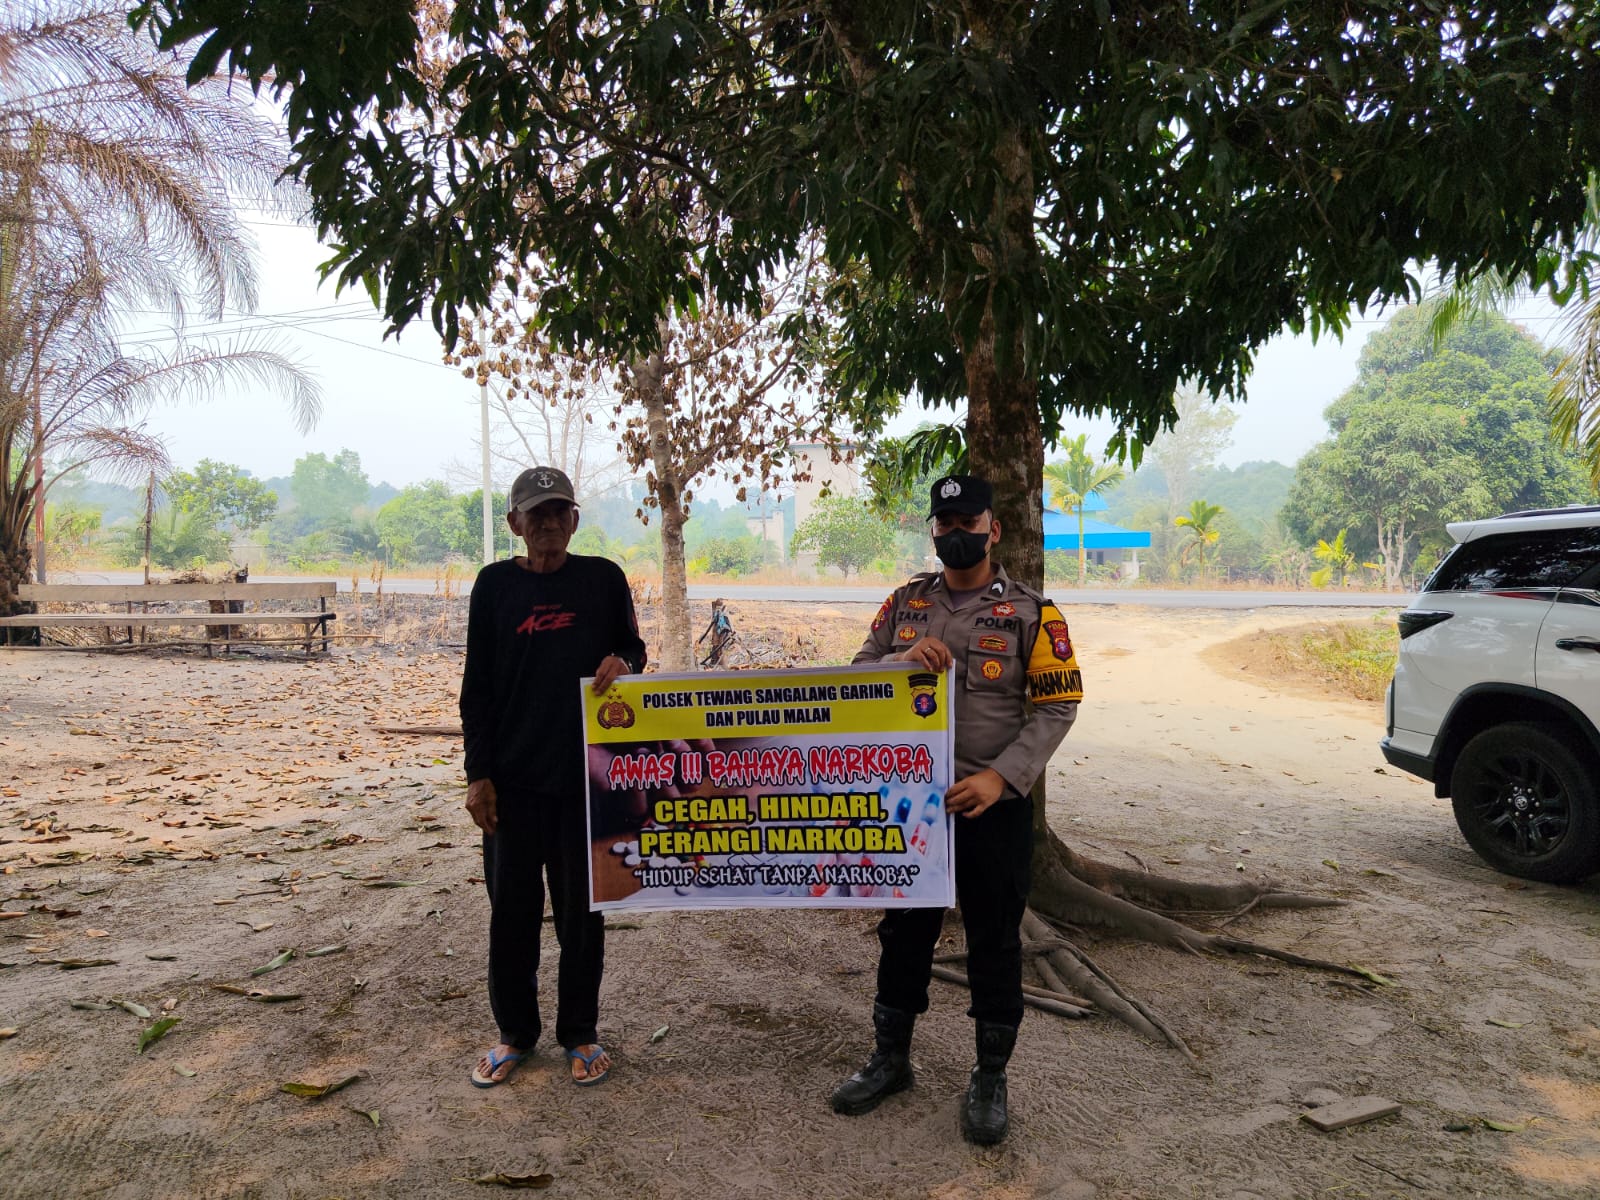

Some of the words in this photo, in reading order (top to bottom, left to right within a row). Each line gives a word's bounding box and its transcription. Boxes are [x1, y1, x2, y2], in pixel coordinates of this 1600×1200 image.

[516, 612, 577, 635] ACE
[898, 611, 928, 623] ZAKA
[975, 616, 1018, 631] POLRI
[643, 691, 693, 709] POLSEK
[695, 689, 753, 706] TEWANG
[756, 685, 837, 704] SANGALANG
[840, 683, 894, 700] GARING
[706, 711, 733, 728] DAN
[737, 709, 781, 726] PULAU
[784, 707, 831, 723] MALAN
[608, 753, 676, 790] AWAS
[707, 747, 805, 788] BAHAYA
[809, 744, 933, 784] NARKOBA
[654, 796, 757, 825] CEGAH,
[760, 792, 888, 823] HINDARI,
[639, 828, 761, 856] PERANGI
[767, 825, 907, 854] NARKOBA
[699, 867, 755, 886] SEHAT
[759, 865, 822, 886] TANPA
